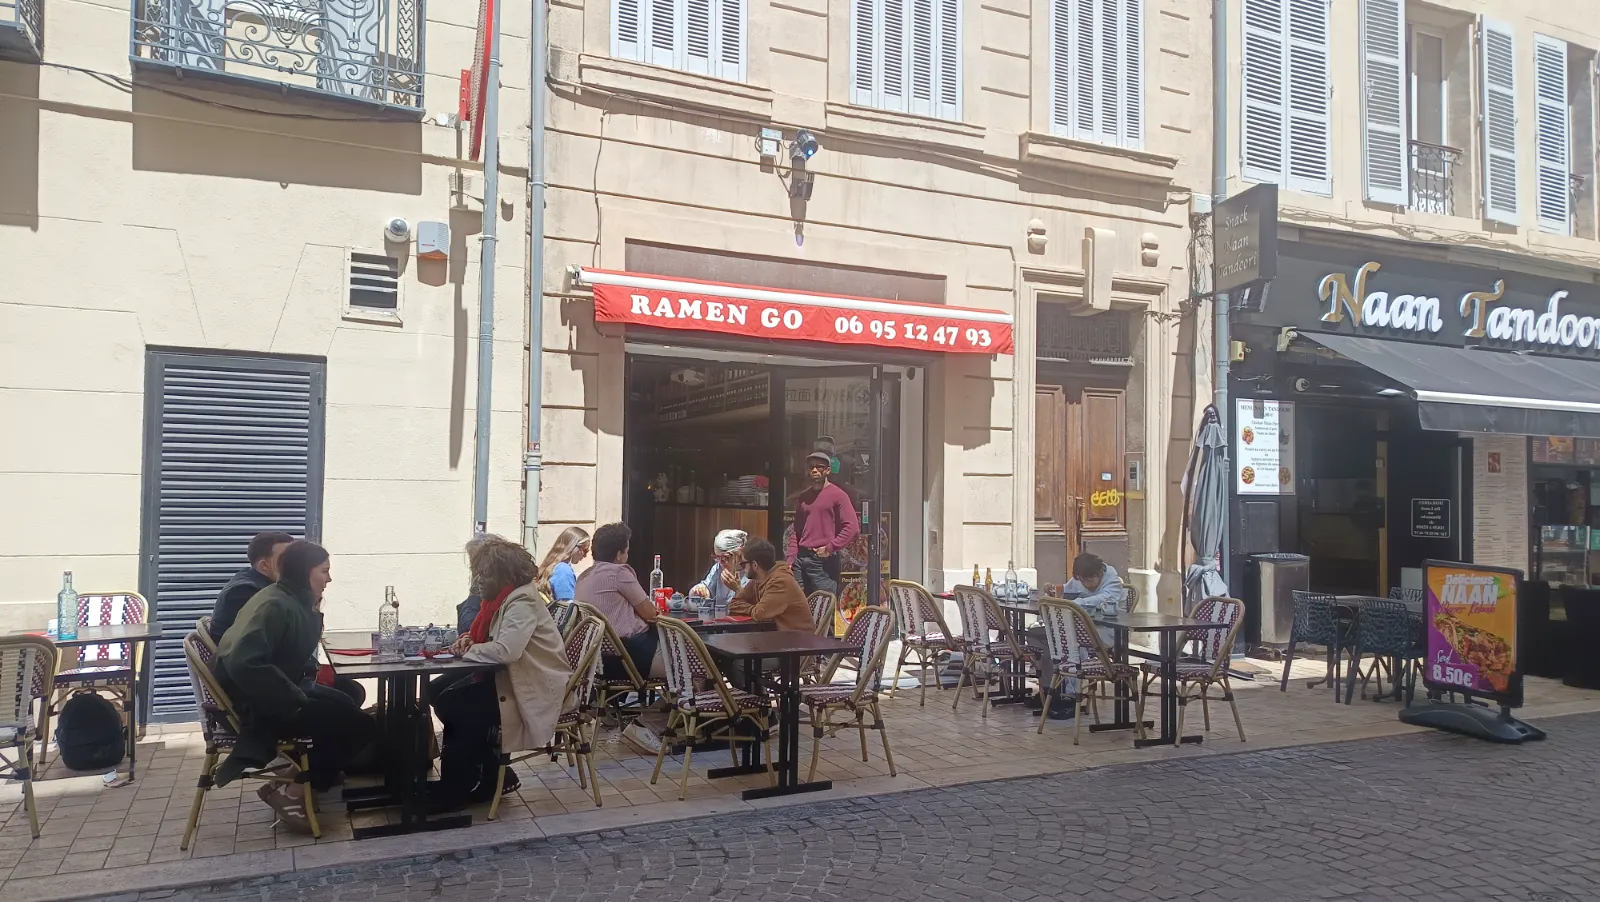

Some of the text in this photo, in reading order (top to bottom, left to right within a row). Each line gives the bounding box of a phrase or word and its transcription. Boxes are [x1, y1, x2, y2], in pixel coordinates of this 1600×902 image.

[1224, 204, 1248, 231] Snack
[1224, 233, 1249, 254] Naan
[1219, 250, 1257, 278] Tandoori
[1318, 261, 1443, 333] Naan
[630, 294, 992, 347] RAMEN GO 06 95 12 47 93
[1440, 584, 1498, 605] NAAN
[1432, 664, 1473, 687] 8.50€
